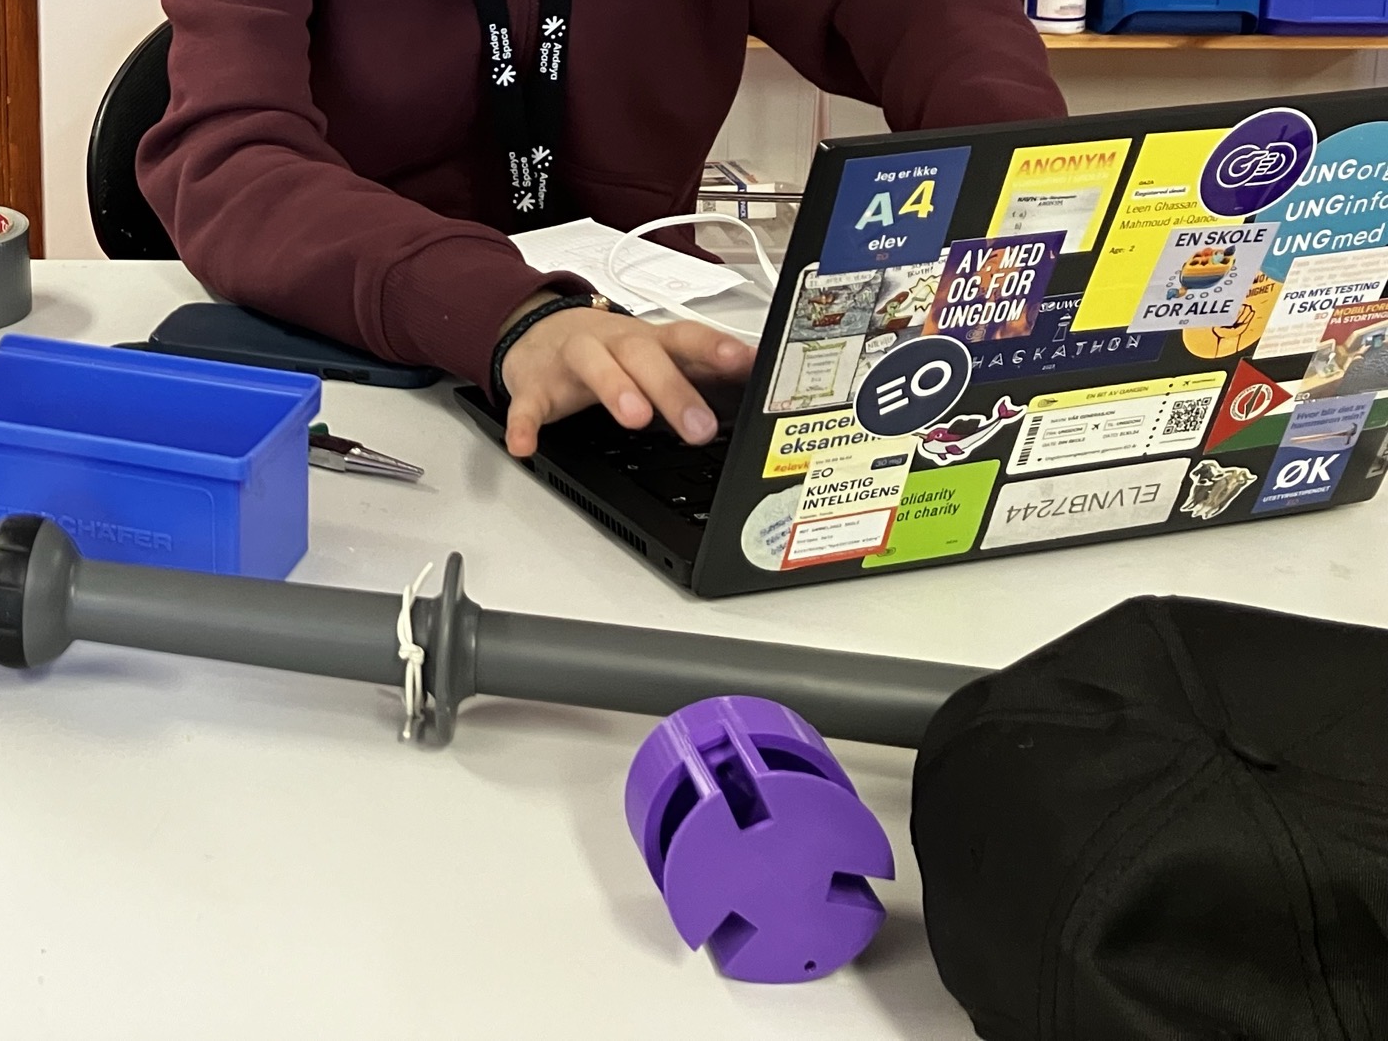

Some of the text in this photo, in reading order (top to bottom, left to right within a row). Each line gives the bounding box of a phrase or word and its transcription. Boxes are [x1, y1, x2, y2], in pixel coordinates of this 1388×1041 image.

[489, 23, 501, 61] Andøya
[500, 28, 513, 59] Space
[539, 42, 551, 73] Space
[548, 42, 562, 80] Andøya
[509, 151, 520, 188] Andøya
[520, 156, 533, 187] Space
[874, 165, 938, 182] Jeg er ikke
[1016, 151, 1117, 176] ANONYM
[854, 180, 935, 230] A4
[1126, 201, 1198, 214] Leen Ghassan
[1119, 218, 1170, 230] Mahmoud
[868, 234, 907, 251] elev
[1175, 228, 1267, 247] EN SKOLE
[1272, 222, 1386, 256] UNGmed
[999, 242, 1046, 270] MED
[947, 269, 1036, 304] OG FOR
[1283, 281, 1381, 300] FOR MYE TESTING
[938, 298, 1027, 330] UNGDOM
[1142, 299, 1234, 319] FOR ALLE
[1297, 411, 1320, 420] Hvor
[1321, 407, 1337, 416] blir
[1338, 405, 1353, 413] det
[780, 431, 882, 455] eksamen
[774, 462, 809, 472] #elevk
[1273, 453, 1340, 490] ØK
[802, 485, 901, 510] INTELLIGENS
[806, 477, 874, 497] KUNSTIG
[900, 488, 956, 506] olidarity
[897, 502, 961, 522] ot charity
[1006, 482, 1162, 524] ELVNB7244
[58, 515, 174, 552] CHÄFER
